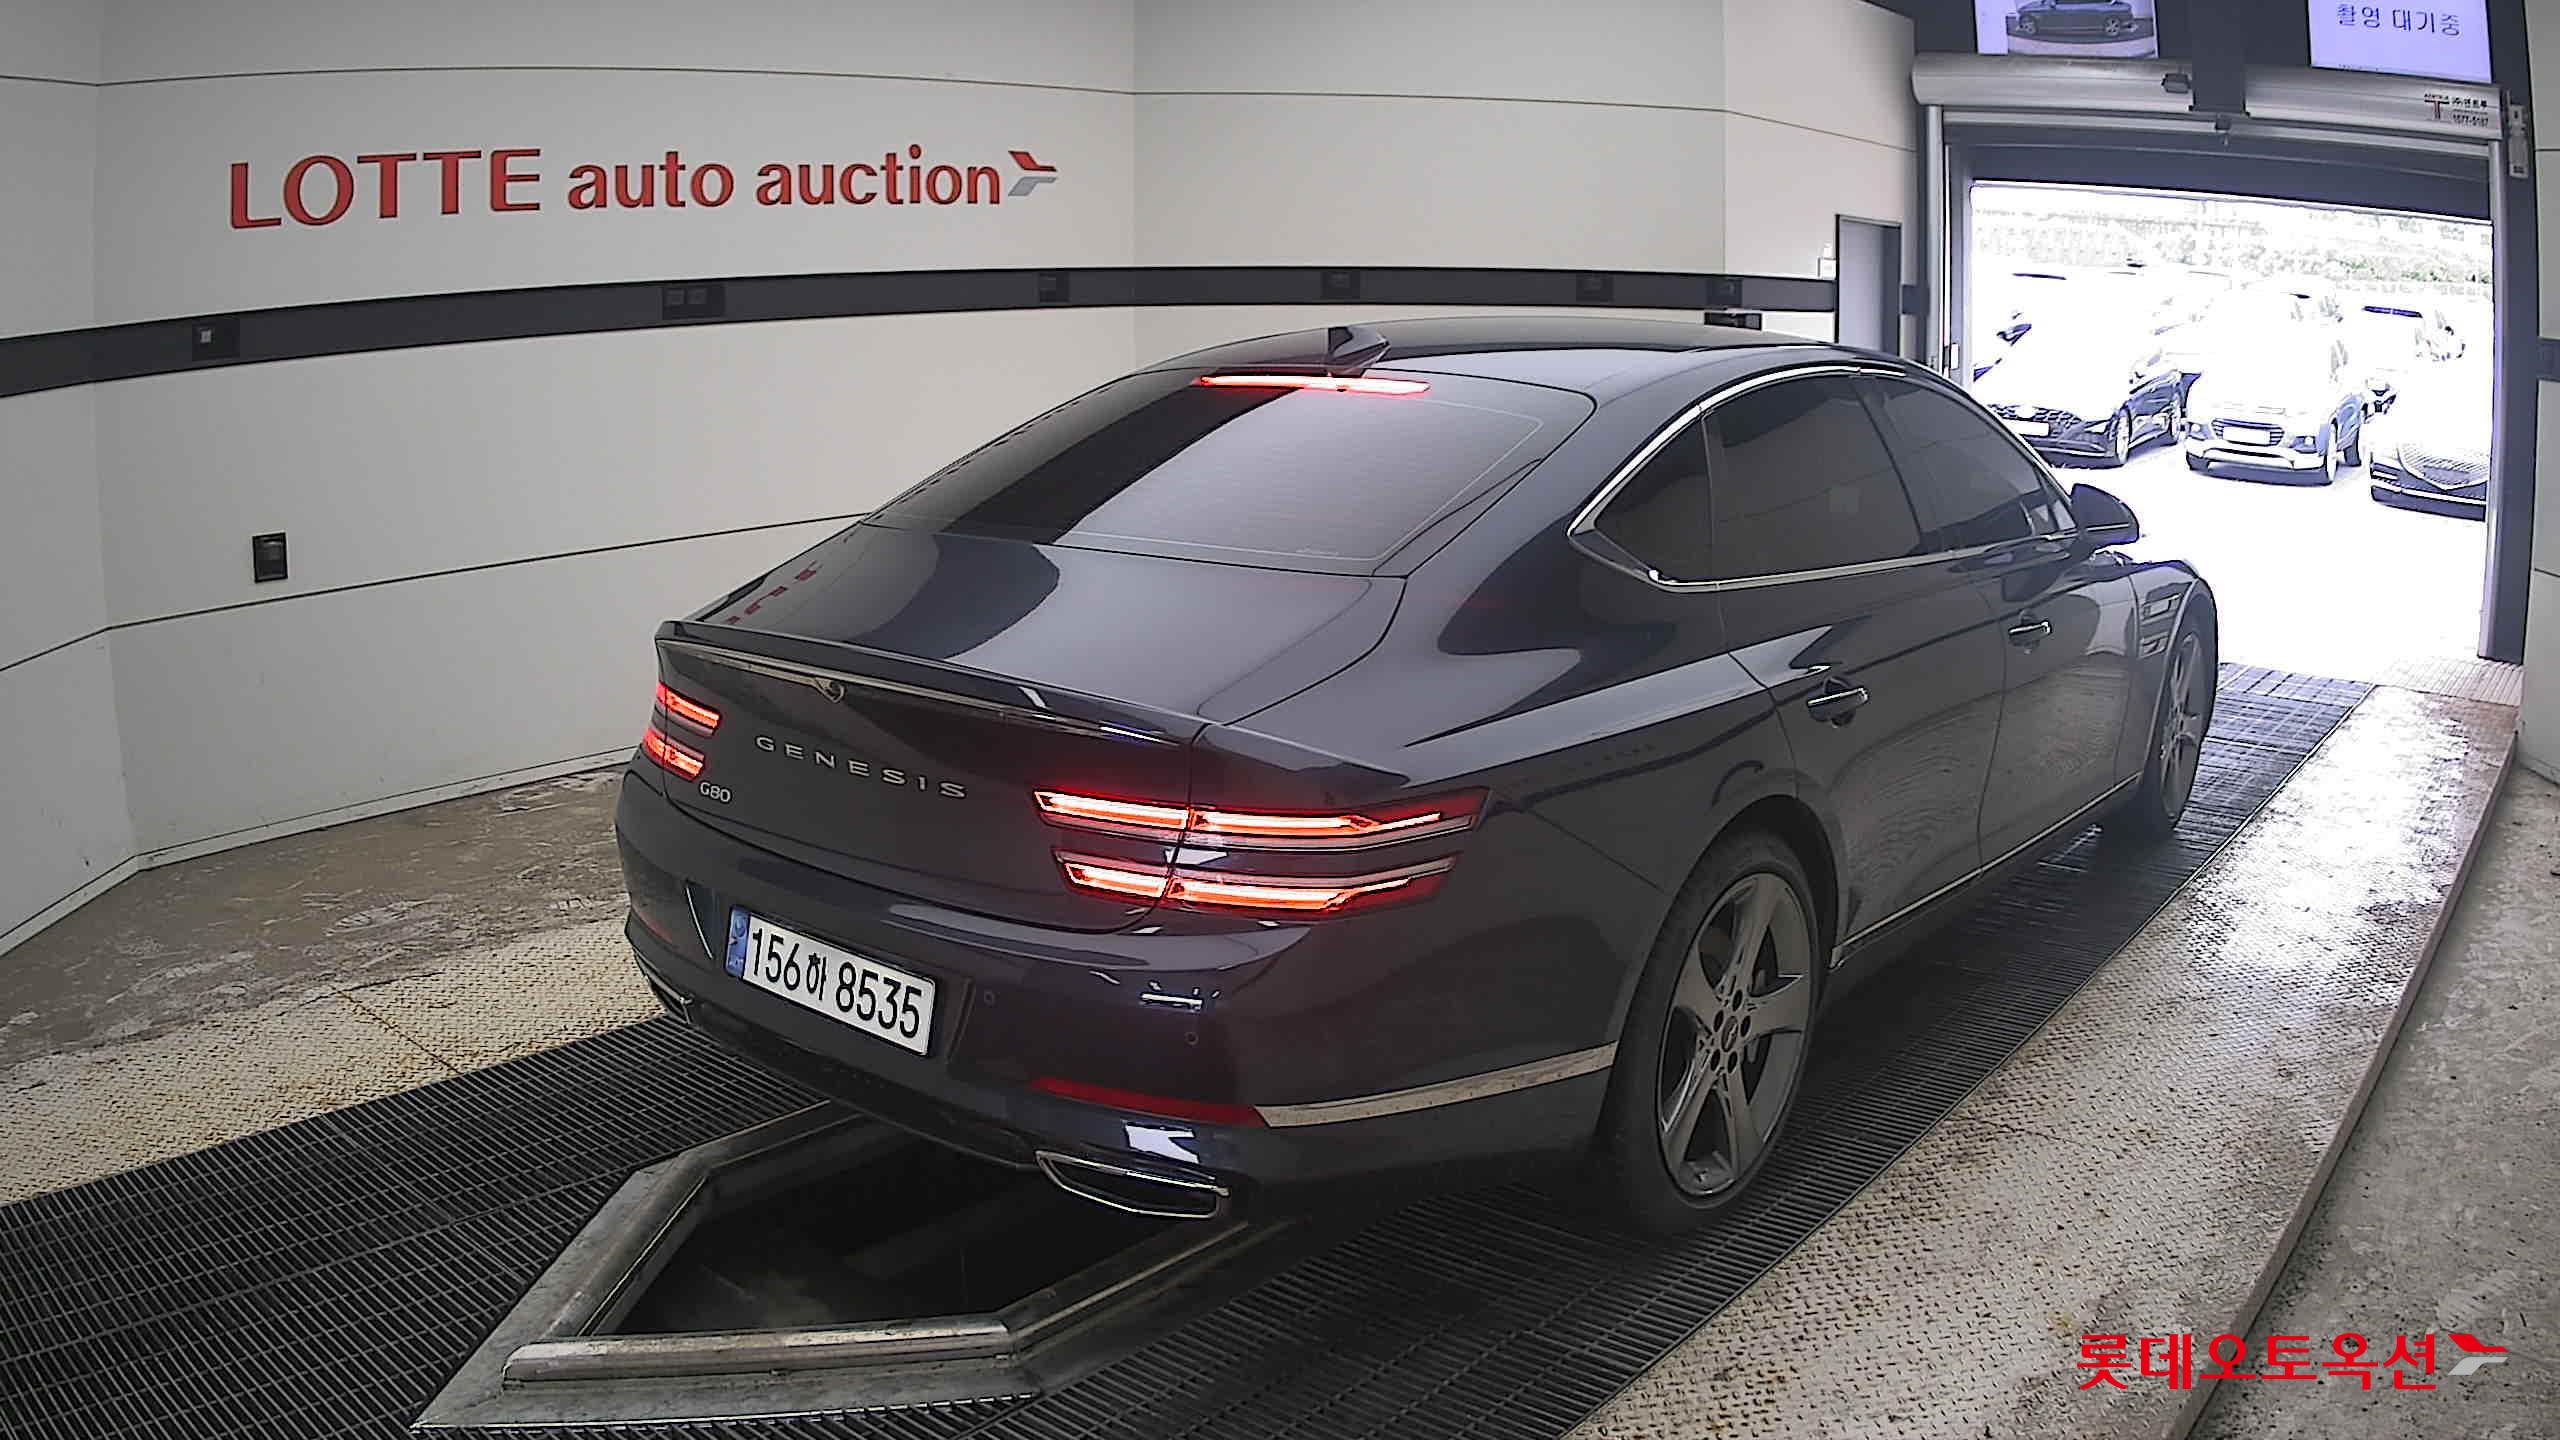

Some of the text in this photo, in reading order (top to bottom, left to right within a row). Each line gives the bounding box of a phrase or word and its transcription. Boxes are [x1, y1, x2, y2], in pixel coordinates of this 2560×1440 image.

[2337, 3, 2461, 36] 촬영 대기중
[231, 144, 1001, 229] LOTTE auto auction
[699, 781, 731, 803] G80
[756, 736, 965, 798] GENESIS
[752, 927, 922, 1039] 156하 8535
